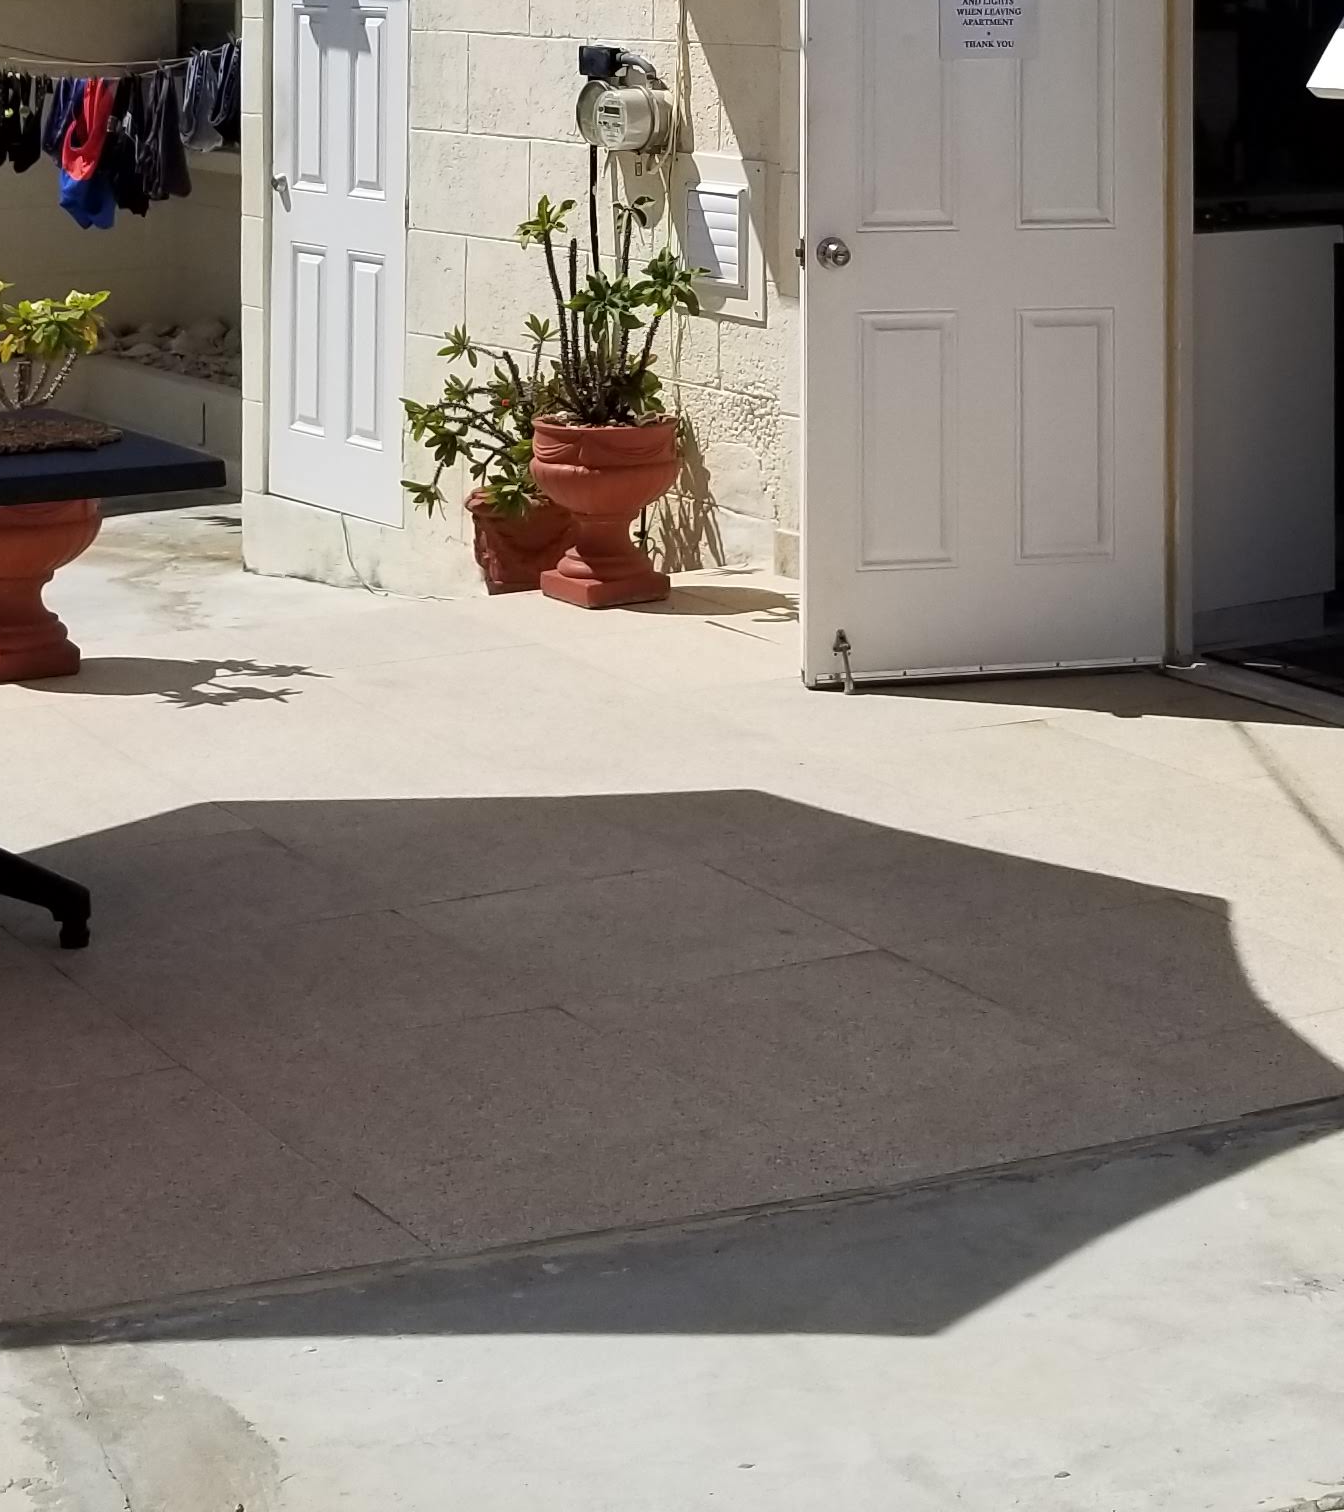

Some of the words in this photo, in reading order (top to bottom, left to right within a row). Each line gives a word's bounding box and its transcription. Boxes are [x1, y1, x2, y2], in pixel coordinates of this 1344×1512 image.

[956, 8, 983, 16] WHEN
[984, 8, 1022, 16] LEAVING
[964, 40, 994, 48] THANK
[996, 40, 1014, 48] YOU
